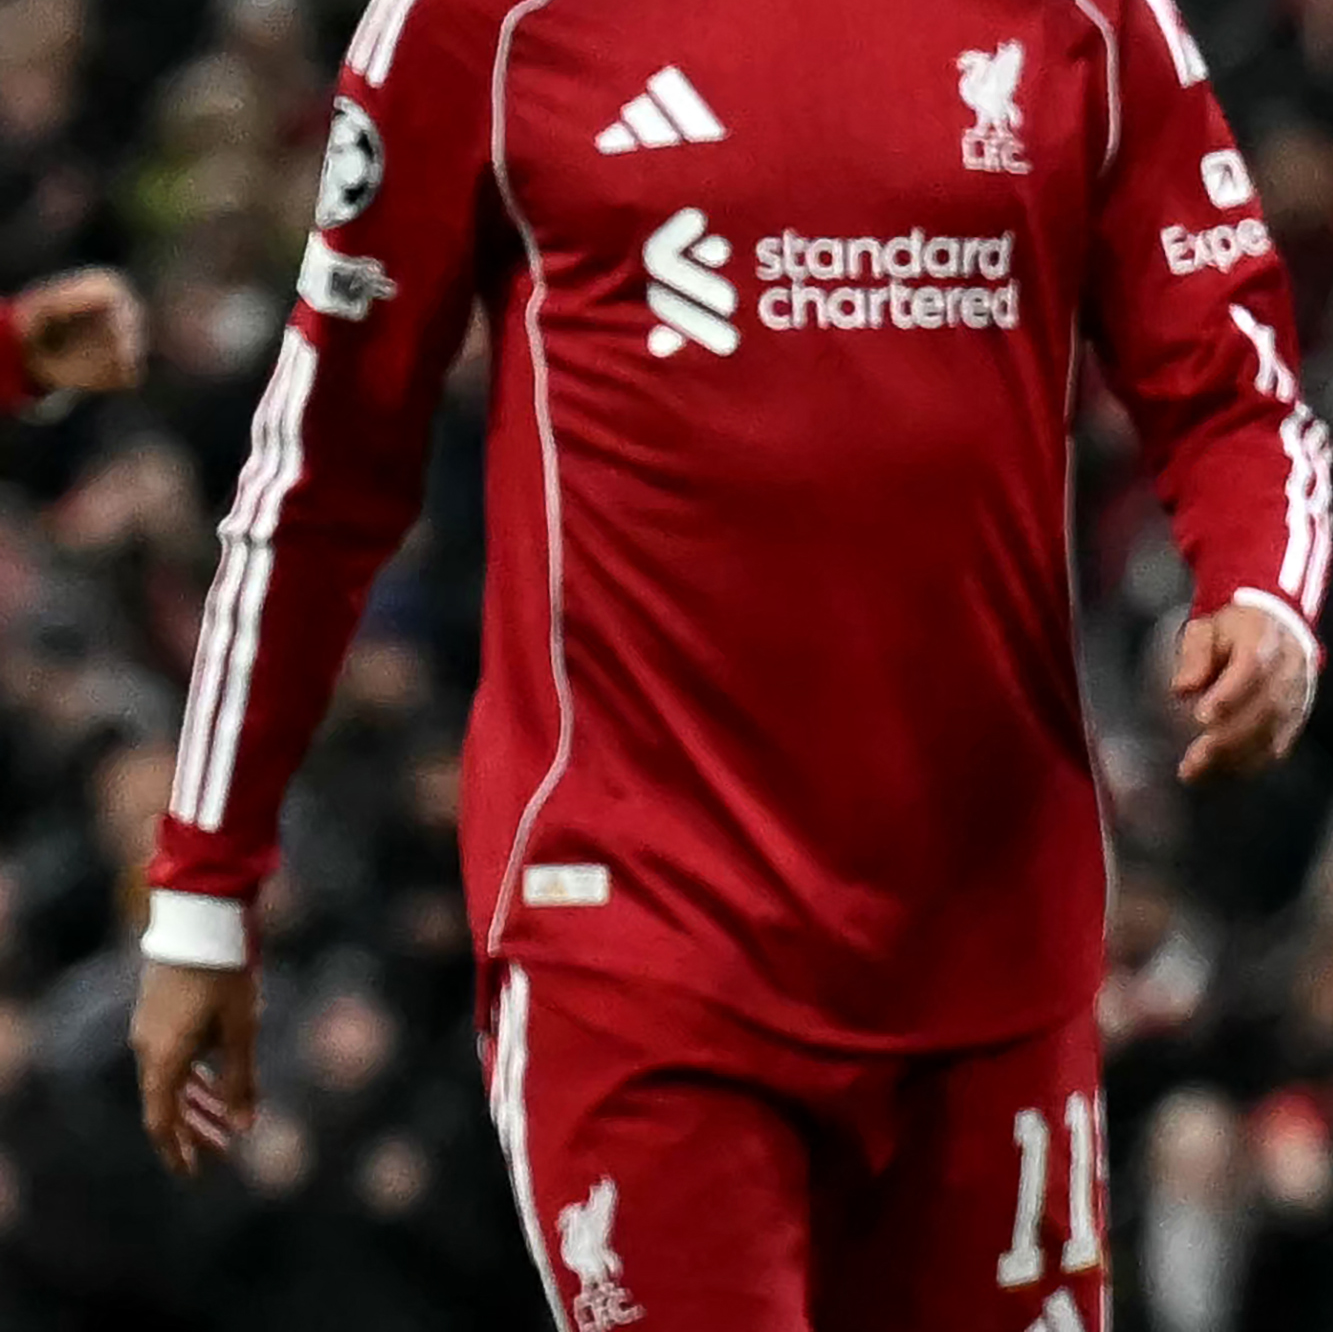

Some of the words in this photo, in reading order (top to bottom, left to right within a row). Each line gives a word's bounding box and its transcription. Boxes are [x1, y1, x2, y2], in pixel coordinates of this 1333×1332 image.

[756, 228, 1015, 281] standard
[757, 278, 1019, 331] chartered
[997, 1091, 1100, 1288] 11
